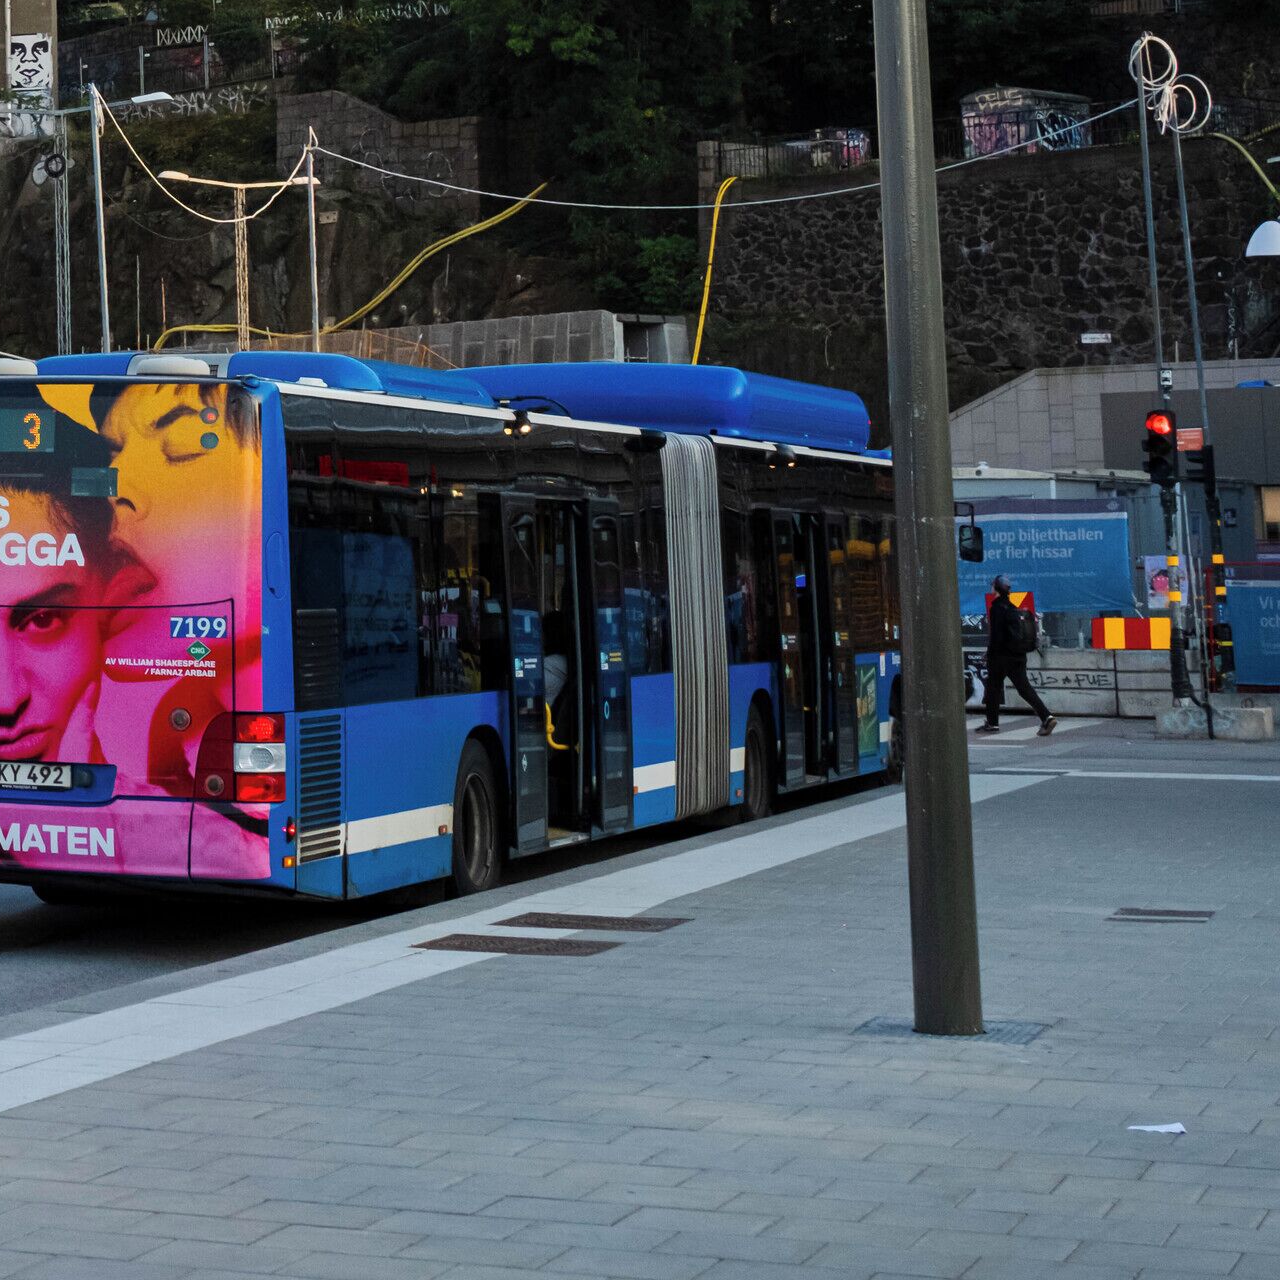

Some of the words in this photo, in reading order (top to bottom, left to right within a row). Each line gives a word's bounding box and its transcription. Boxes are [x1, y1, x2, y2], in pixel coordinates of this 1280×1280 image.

[22, 411, 42, 451] 3
[990, 529, 1016, 544] upp
[1018, 527, 1104, 542] biljetthallen
[1006, 546, 1028, 558] fler
[1031, 545, 1074, 559] hissar
[170, 616, 227, 638] 7199
[190, 646, 206, 655] CNG
[105, 657, 117, 665] AV
[118, 658, 153, 667] WILLIAM
[155, 659, 216, 668] SHAKESPEARE
[150, 668, 183, 677] FARNAZ
[184, 669, 216, 678] ARBABI
[27, 765, 64, 785] 492
